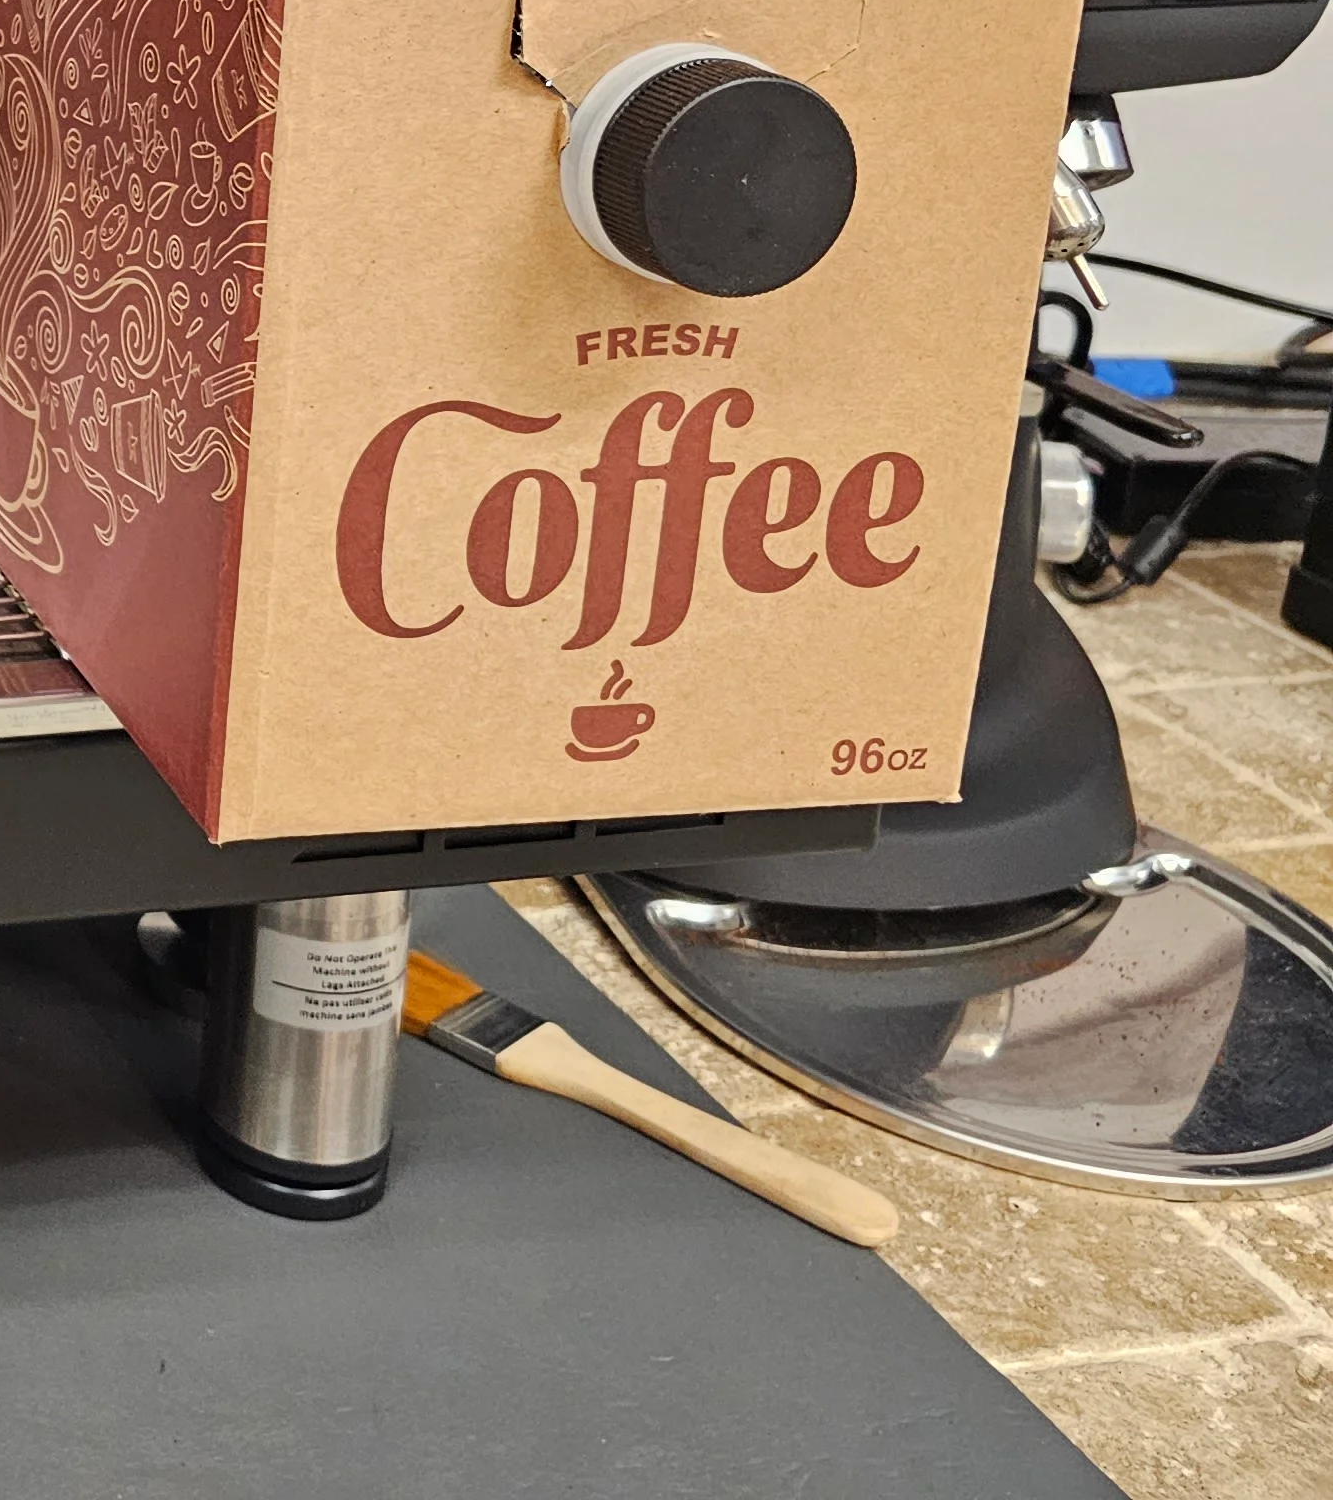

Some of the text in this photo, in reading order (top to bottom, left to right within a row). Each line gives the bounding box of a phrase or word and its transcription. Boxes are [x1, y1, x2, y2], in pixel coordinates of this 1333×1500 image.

[575, 323, 740, 367] FRESH
[335, 387, 925, 651] Coffee
[831, 737, 928, 776] 96oz
